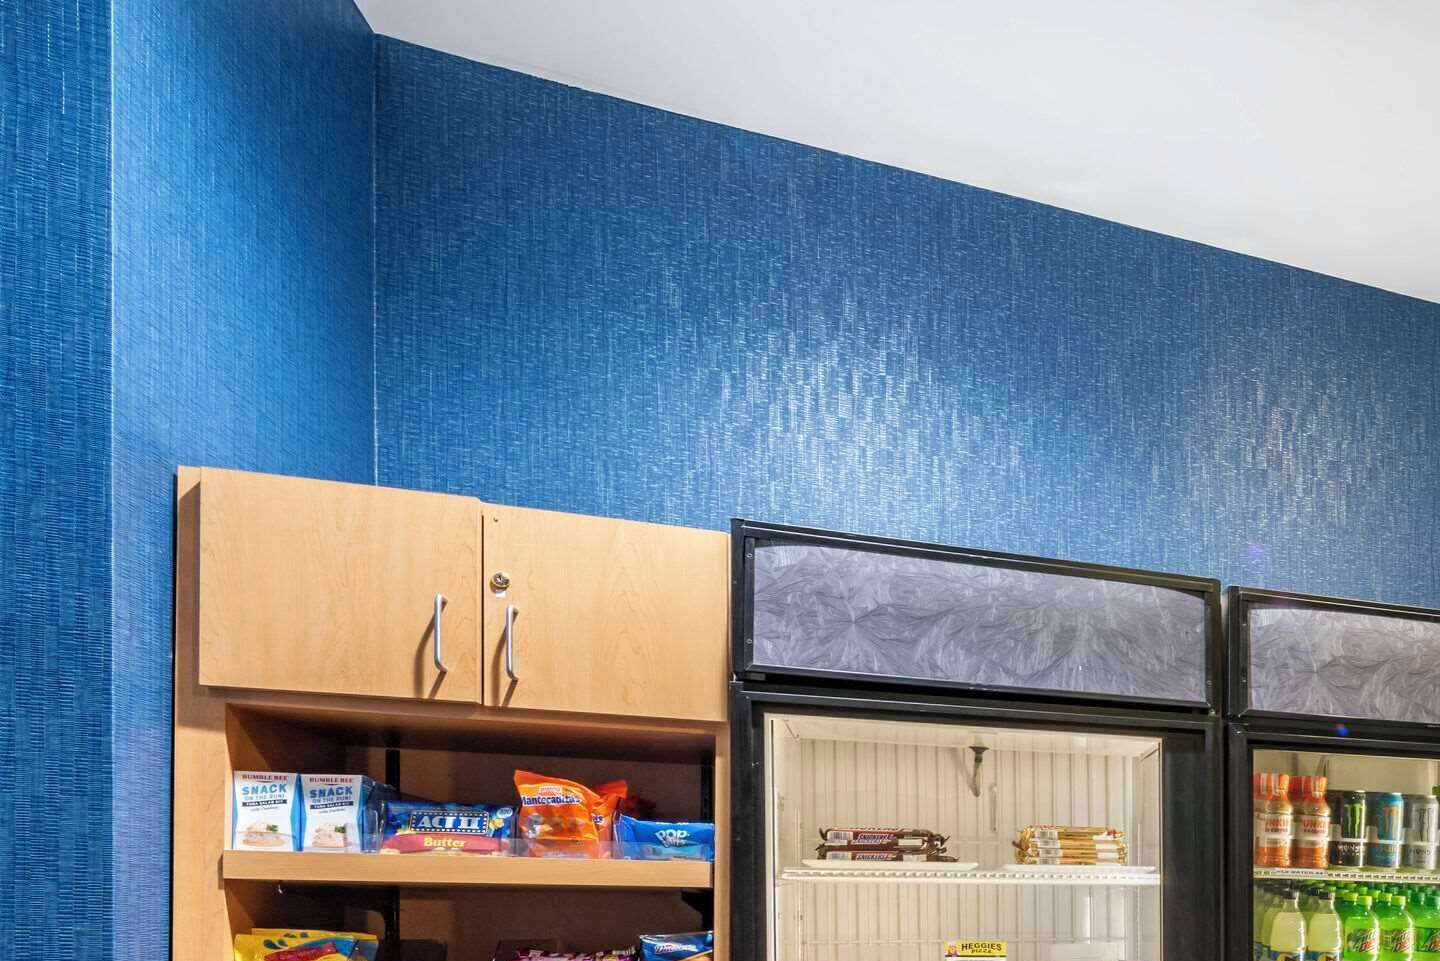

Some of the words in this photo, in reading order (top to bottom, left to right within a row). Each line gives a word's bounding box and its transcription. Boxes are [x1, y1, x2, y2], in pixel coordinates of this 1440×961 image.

[241, 784, 287, 796] SNACK
[309, 786, 352, 799] SNACK
[417, 815, 455, 829] ACT
[457, 815, 480, 829] II
[424, 836, 466, 847] Butter
[961, 942, 1002, 951] HEGGIES
